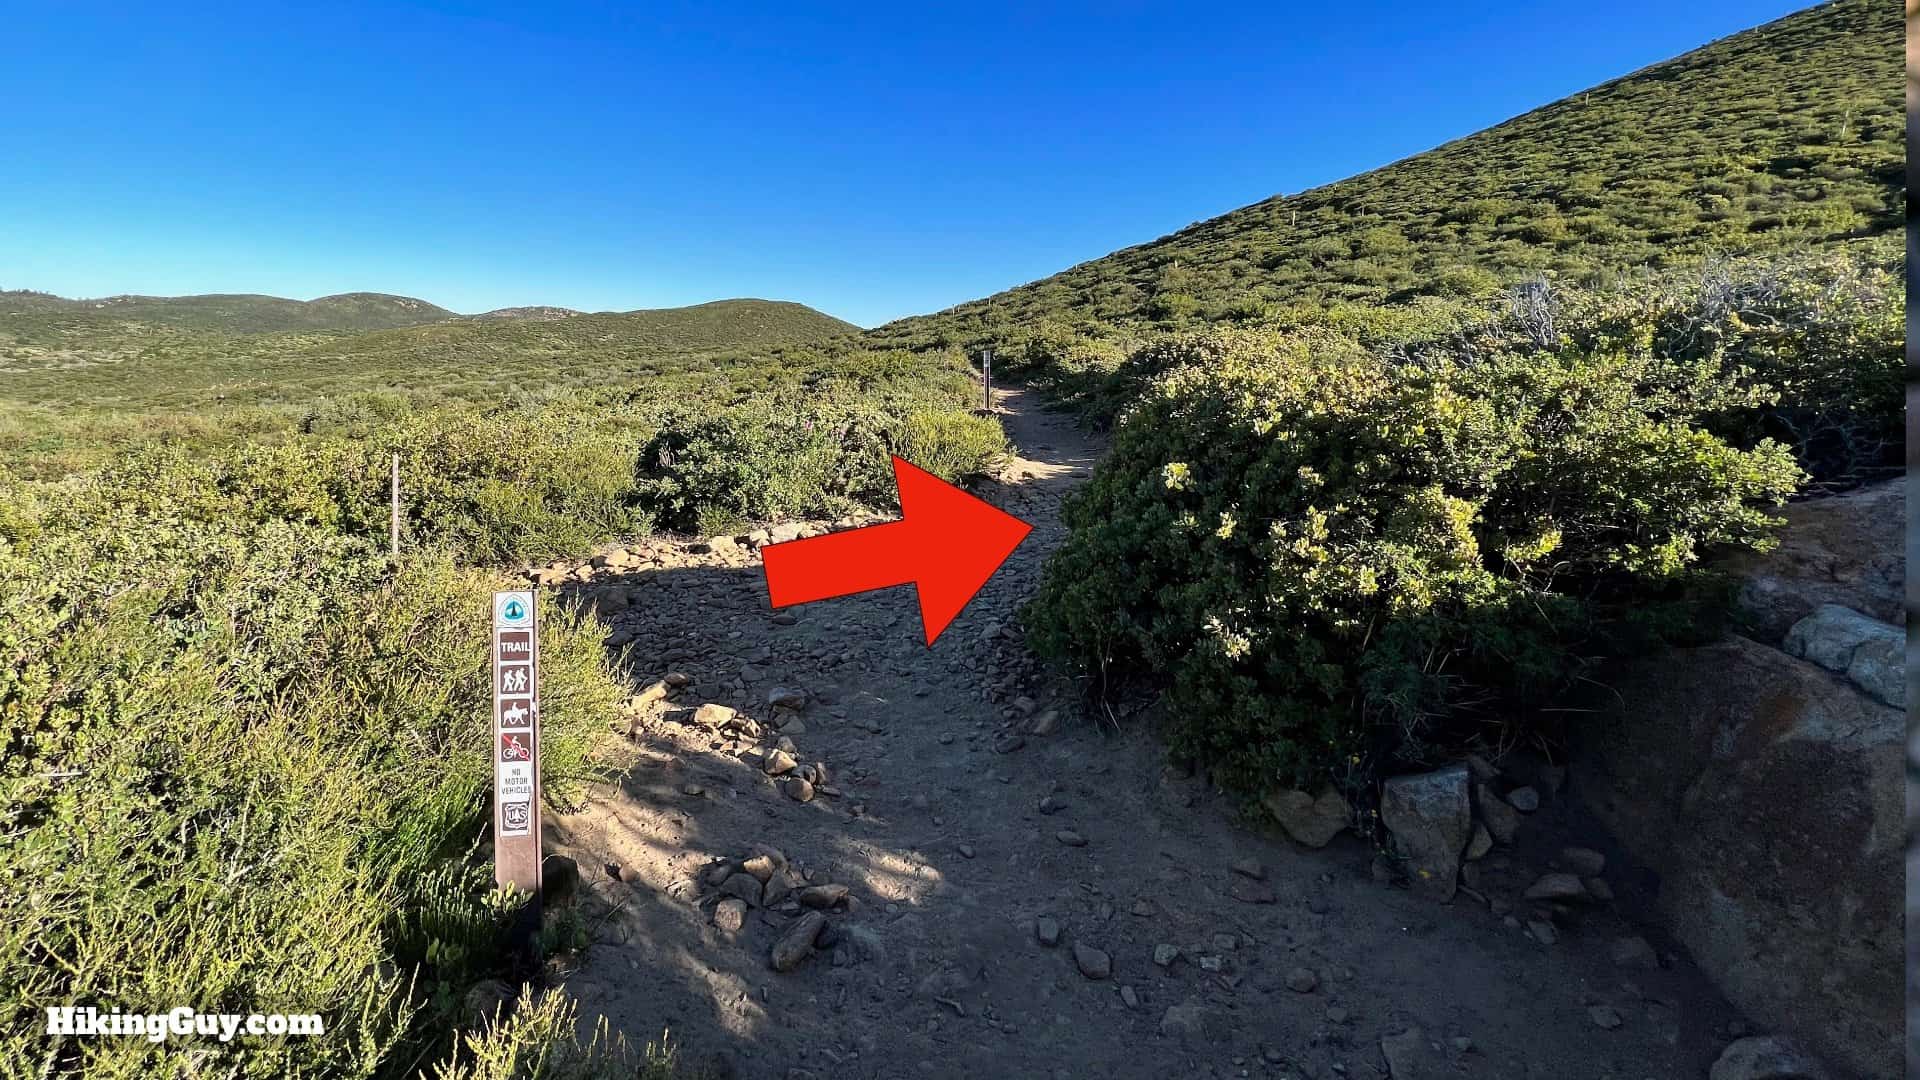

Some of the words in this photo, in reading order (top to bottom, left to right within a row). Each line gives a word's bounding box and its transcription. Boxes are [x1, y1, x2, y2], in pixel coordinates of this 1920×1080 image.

[501, 642, 529, 652] TRAIL
[512, 768, 520, 776] NO
[505, 777, 527, 785] MOTOR
[502, 786, 531, 794] VEHICLES
